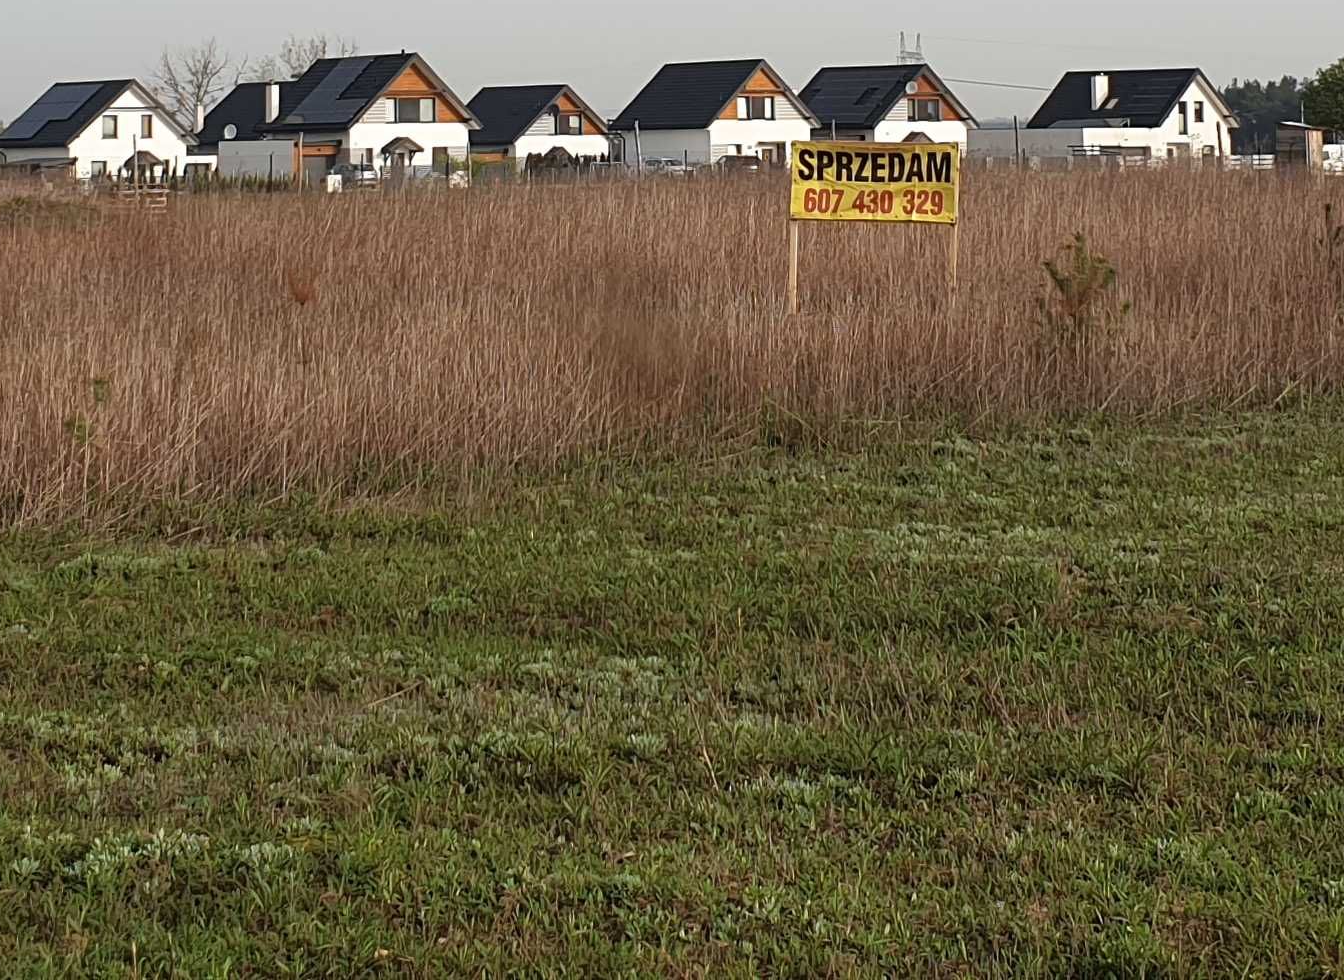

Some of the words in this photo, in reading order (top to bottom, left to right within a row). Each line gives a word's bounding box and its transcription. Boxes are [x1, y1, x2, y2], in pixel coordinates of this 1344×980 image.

[798, 149, 951, 183] SPRZEDAM
[803, 188, 844, 213] 607
[852, 189, 894, 214] 430
[902, 189, 944, 215] 329
